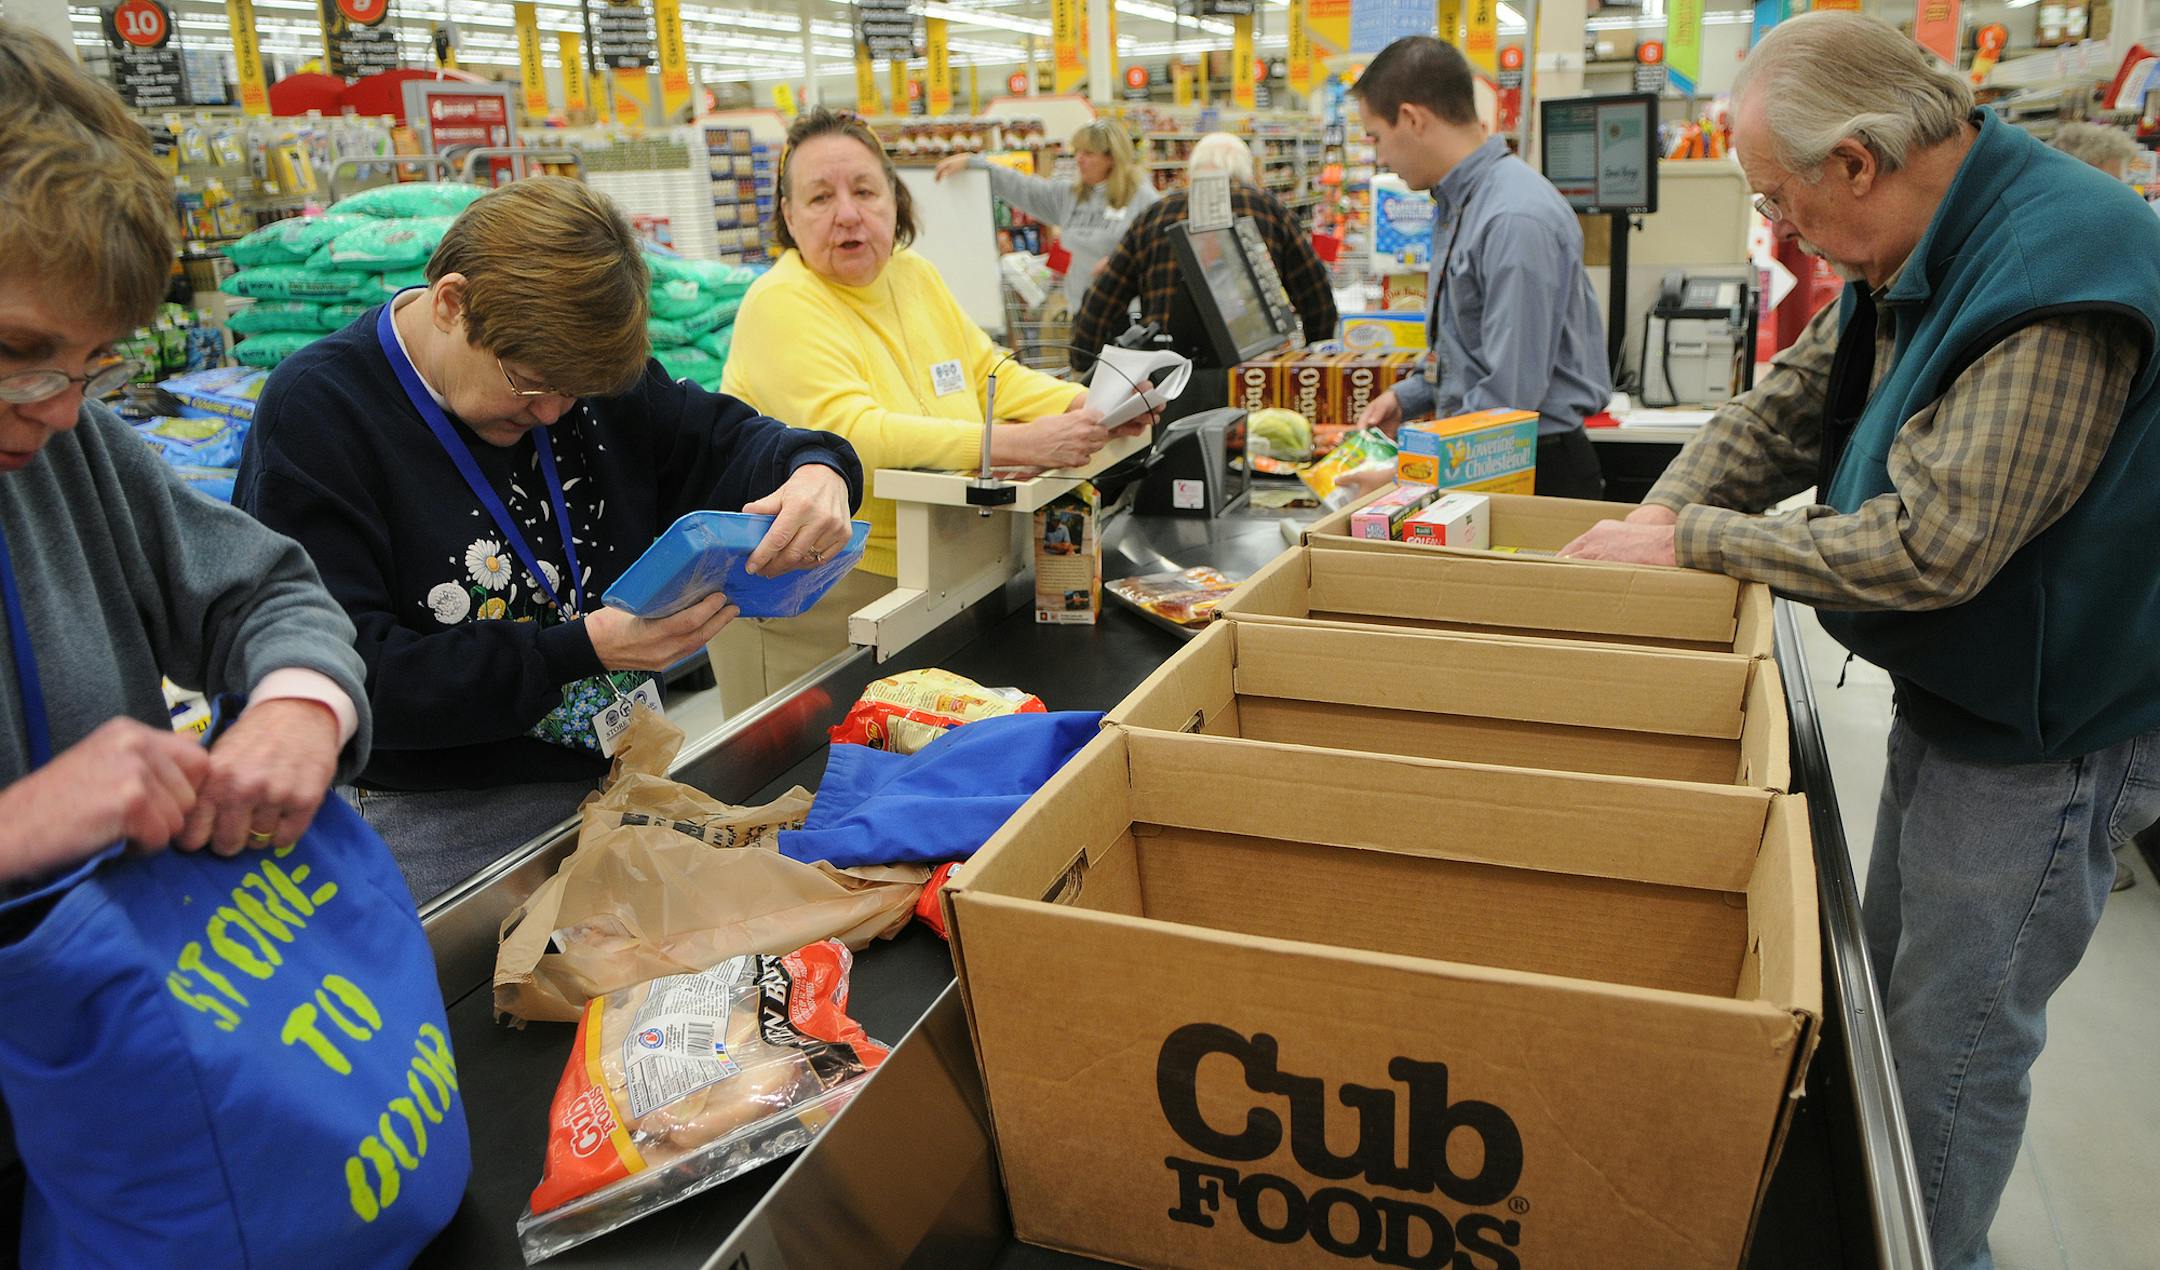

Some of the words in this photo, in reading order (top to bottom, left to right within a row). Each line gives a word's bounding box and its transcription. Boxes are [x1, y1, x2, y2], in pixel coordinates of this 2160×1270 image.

[124, 10, 158, 36] 10
[1465, 447, 1531, 480] Cholesterol!
[1466, 434, 1516, 460] Lowering
[165, 841, 338, 1032] STORE
[280, 974, 383, 1076] TO
[344, 1022, 459, 1224] DOOR
[561, 1095, 606, 1159] Cub
[589, 1081, 617, 1141] FOODS
[1157, 1022, 1524, 1207] Cub
[1164, 1156, 1522, 1270] FOODS
